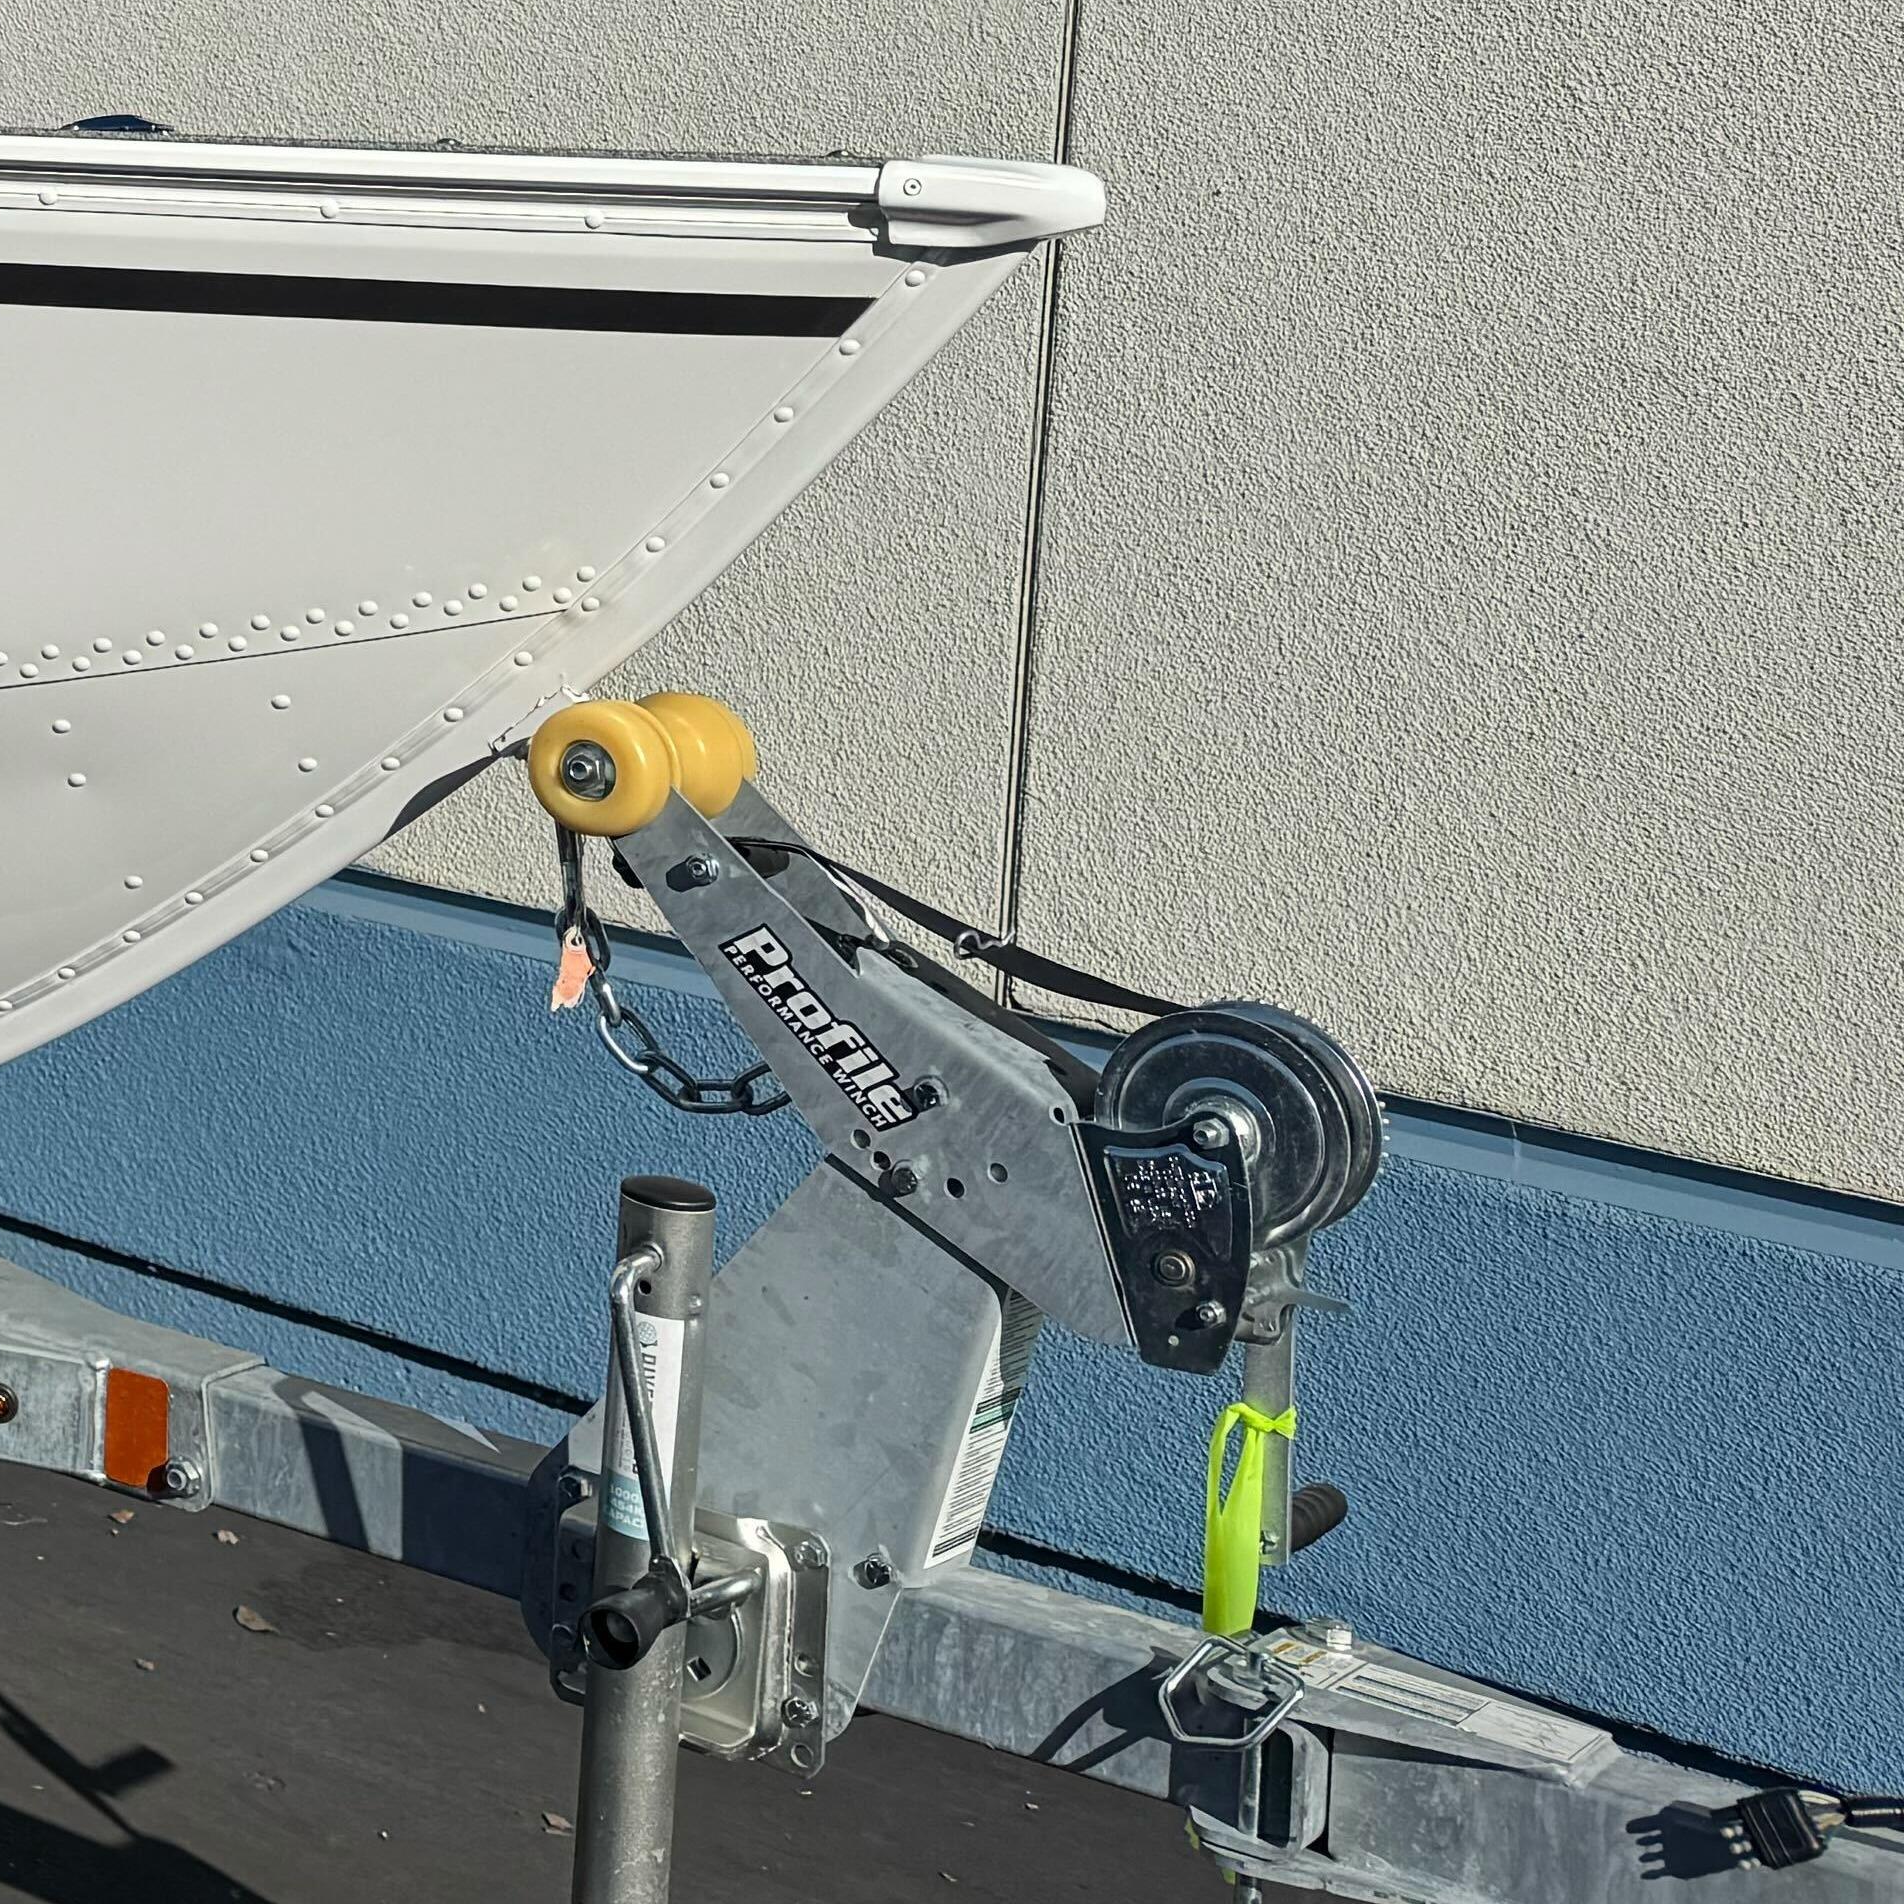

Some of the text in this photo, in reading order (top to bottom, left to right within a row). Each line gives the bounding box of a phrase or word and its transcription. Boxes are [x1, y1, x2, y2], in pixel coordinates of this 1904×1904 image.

[723, 945, 888, 1127] PERFORMANCE WINCH
[733, 926, 913, 1125] Profile
